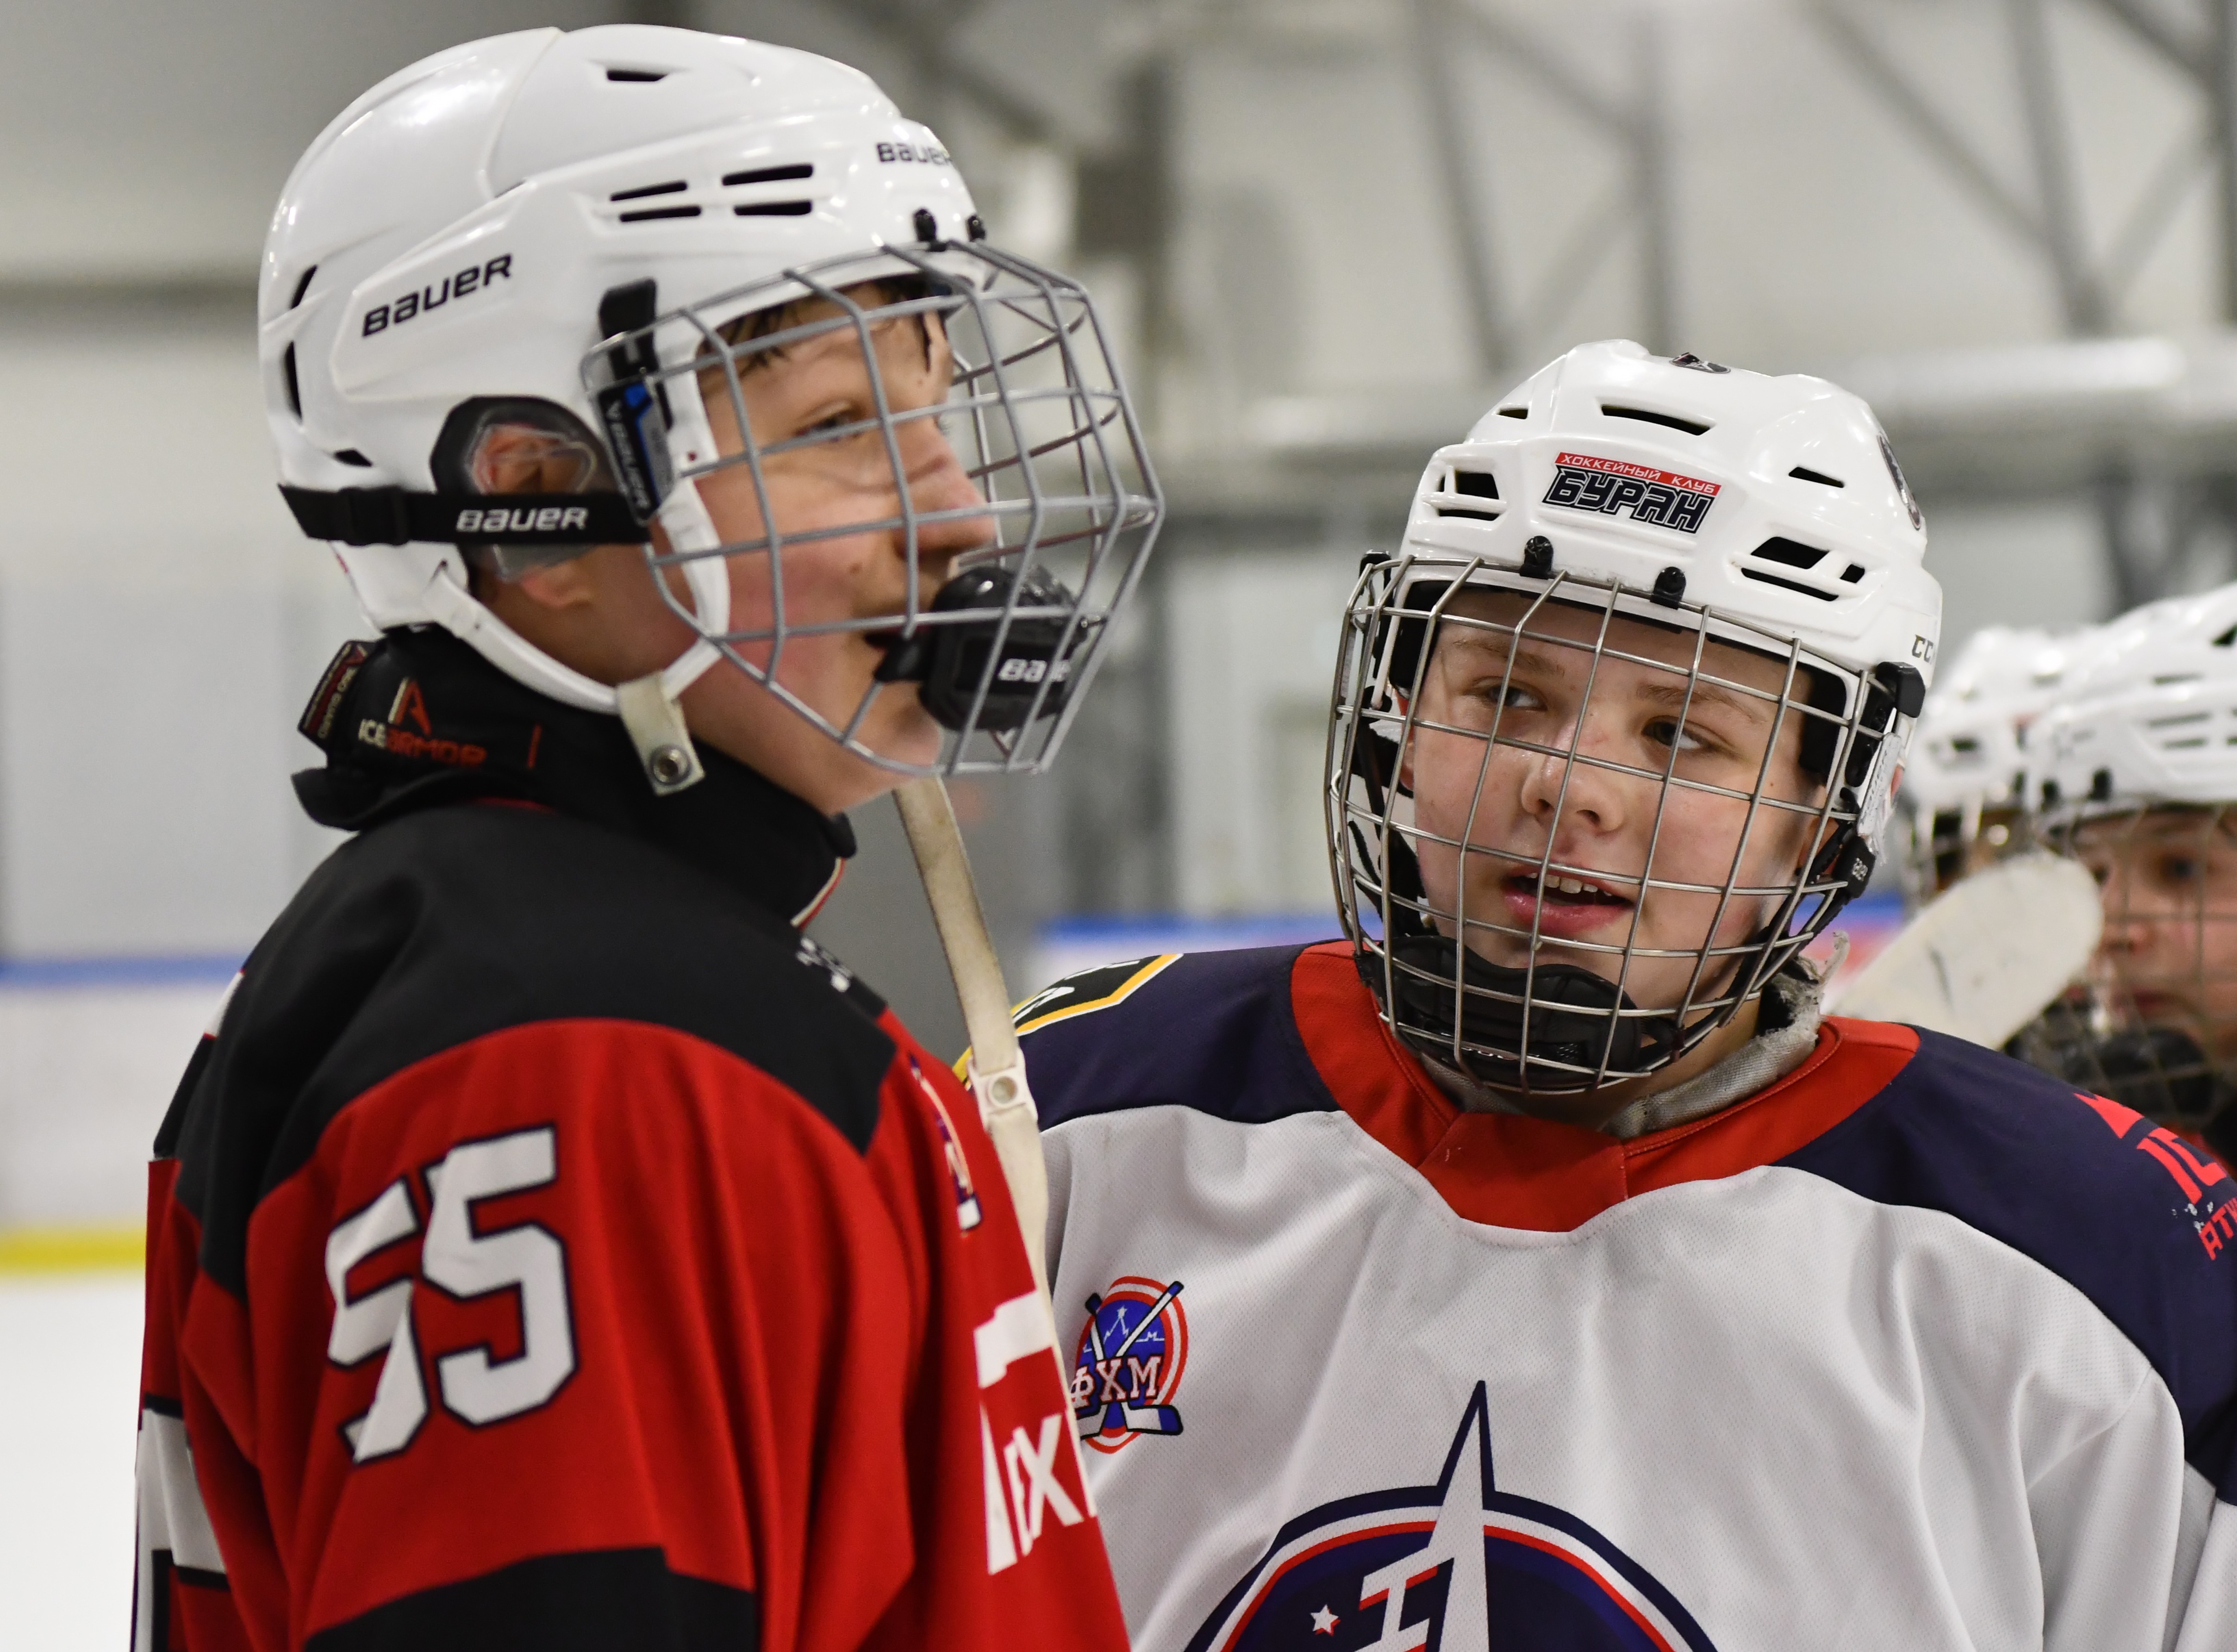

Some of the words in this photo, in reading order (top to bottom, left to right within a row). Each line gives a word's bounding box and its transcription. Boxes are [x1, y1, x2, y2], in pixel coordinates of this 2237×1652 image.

[362, 252, 512, 338] BAUER
[1543, 465, 1715, 534] БУРАН
[1561, 454, 1662, 480] ХОККЕЙНЫЙ
[1671, 475, 1715, 494] КЛУБ
[456, 507, 588, 532] BAUER
[1912, 634, 1936, 665] CC
[322, 1120, 579, 1466] 55
[1071, 1356, 1164, 1410] ФХМ
